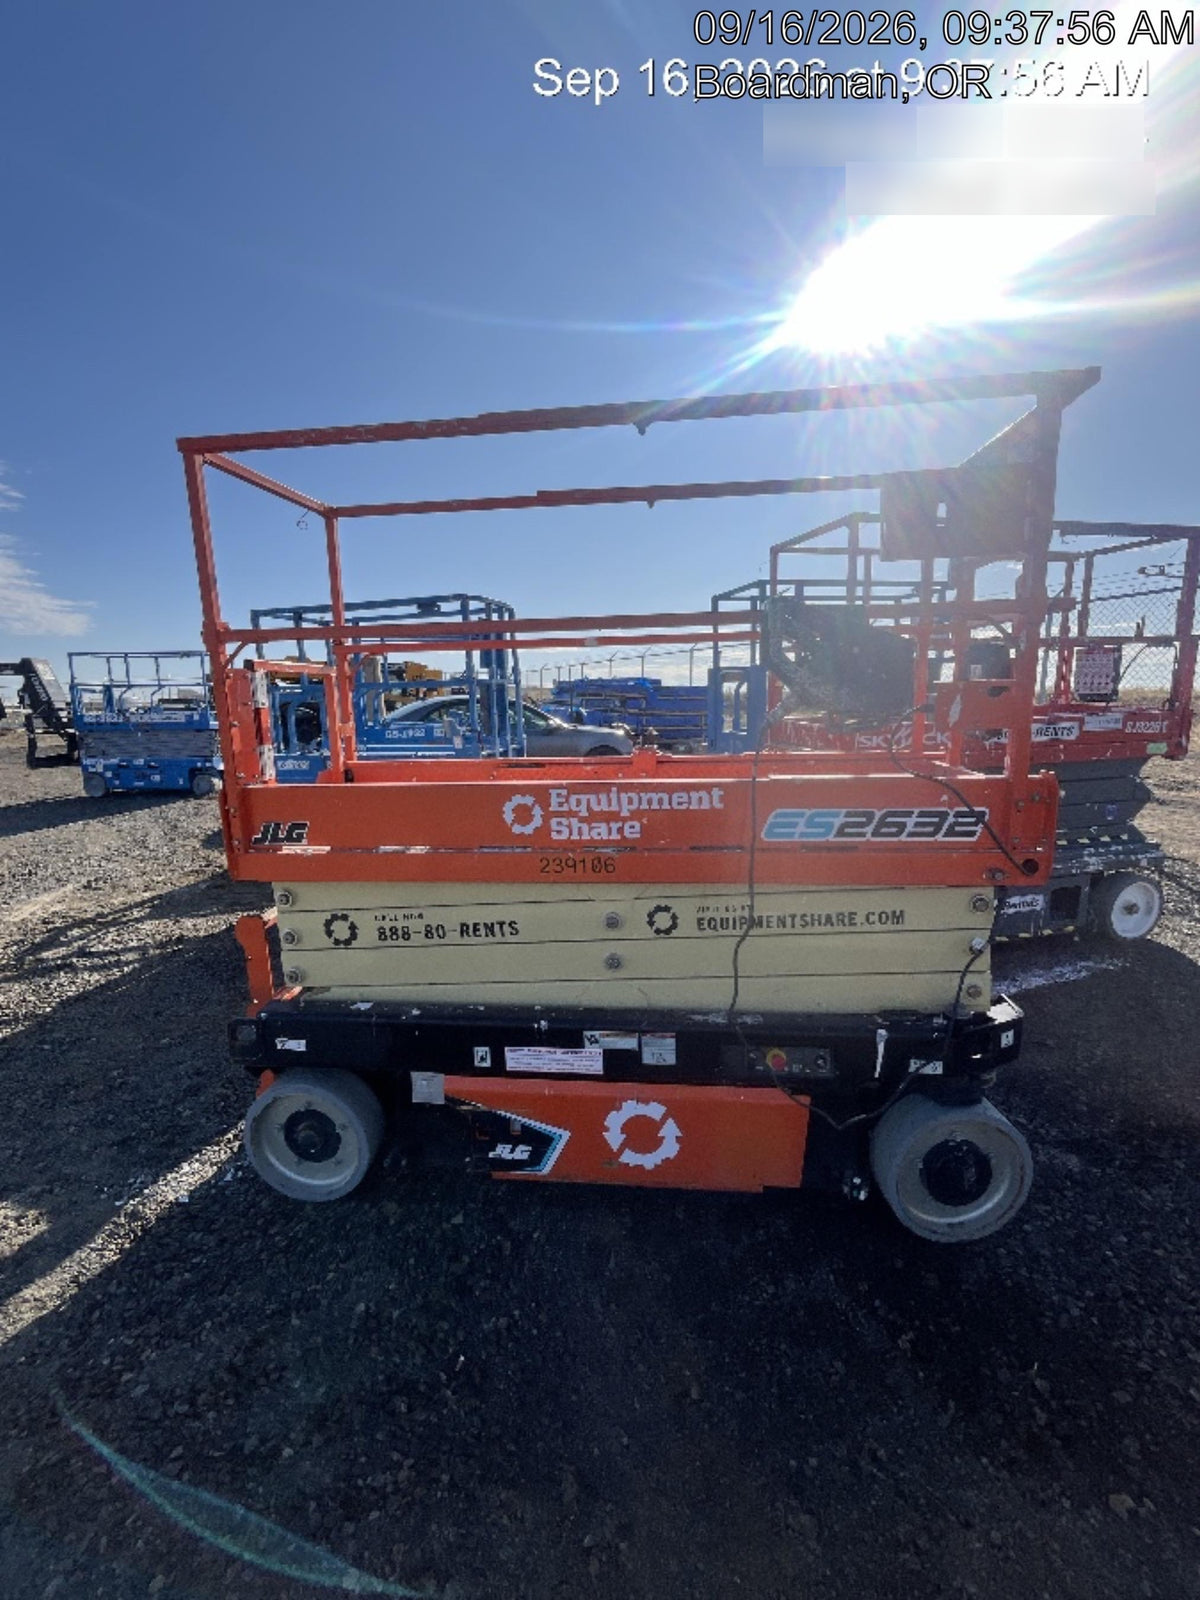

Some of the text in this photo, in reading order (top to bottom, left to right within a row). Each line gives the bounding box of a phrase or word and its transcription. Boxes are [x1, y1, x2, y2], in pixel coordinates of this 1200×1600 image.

[549, 788, 725, 815] Equipment
[251, 821, 309, 846] JLG
[550, 816, 642, 840] Share
[761, 808, 989, 842] ES2632
[539, 856, 616, 875] 239106
[377, 921, 520, 941] 888-80-RENTS
[696, 909, 905, 931] EQUIPMENTSHARE.COM
[488, 1143, 532, 1160] JLG
